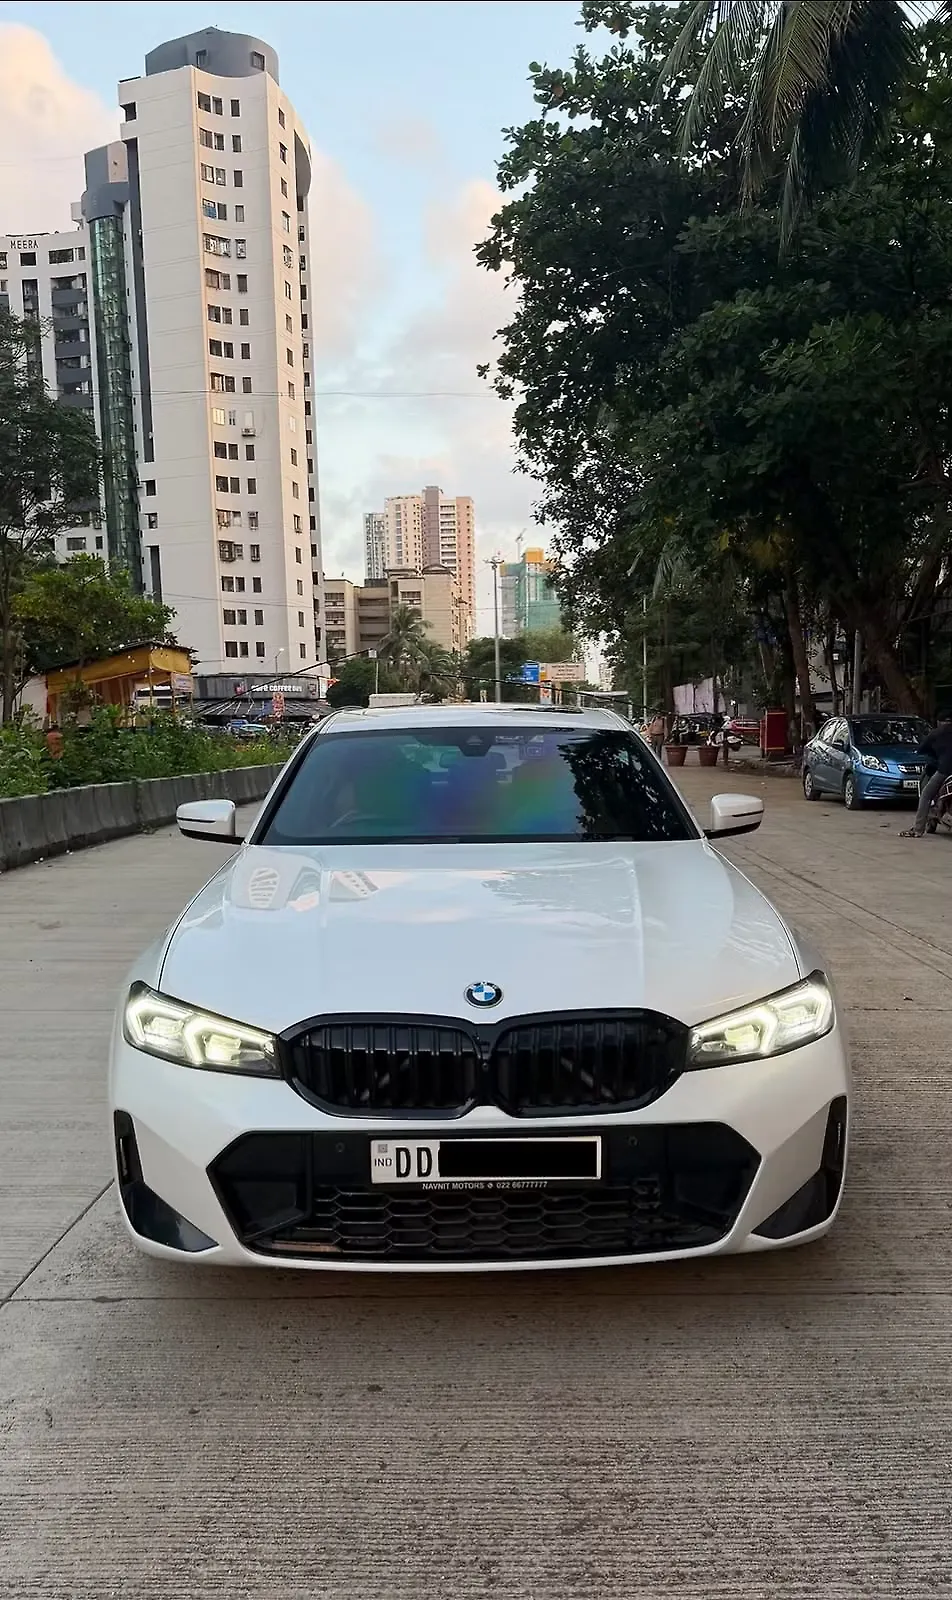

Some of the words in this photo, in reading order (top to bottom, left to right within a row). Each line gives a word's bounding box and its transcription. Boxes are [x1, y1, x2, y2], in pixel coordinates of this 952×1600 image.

[10, 240, 39, 249] MEERA
[374, 1158, 392, 1168] IND
[452, 1182, 485, 1190] MOTORS
